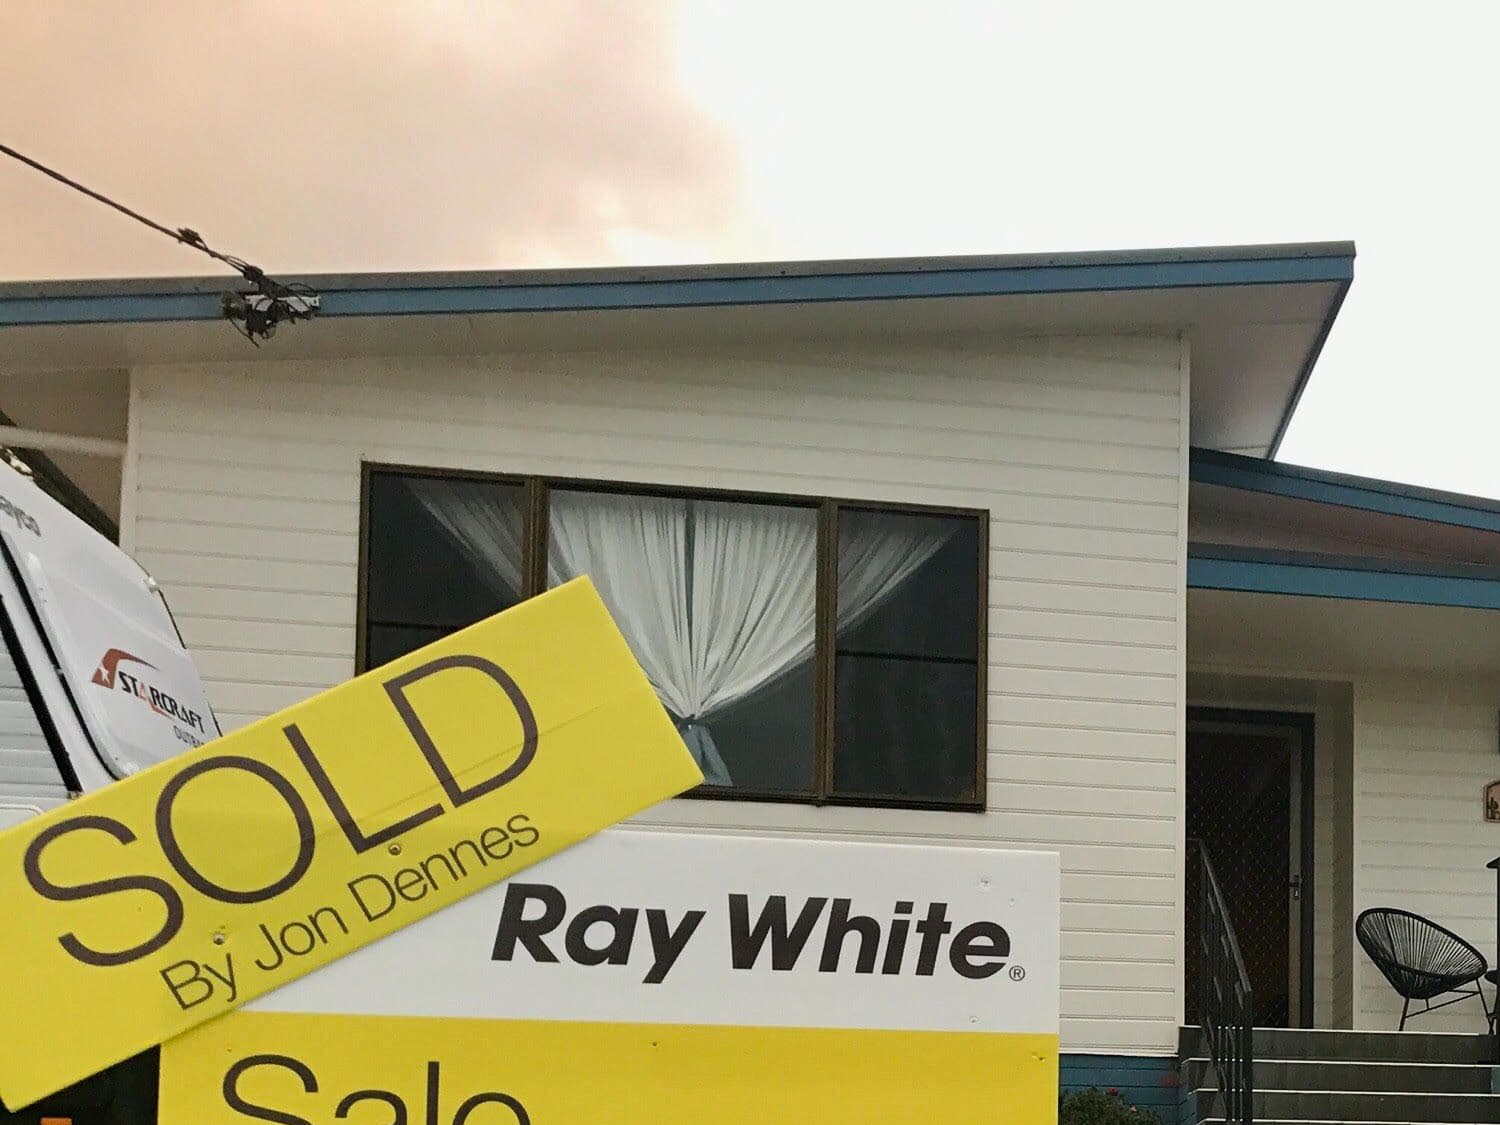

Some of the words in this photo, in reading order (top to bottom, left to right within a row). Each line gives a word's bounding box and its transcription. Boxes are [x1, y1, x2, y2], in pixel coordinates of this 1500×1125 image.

[118, 670, 205, 734] STARCRAFT
[23, 655, 540, 967] SOLD
[159, 952, 237, 1011] By
[255, 906, 349, 972] Jon
[347, 813, 541, 922] Dennes
[490, 882, 705, 984] Ray
